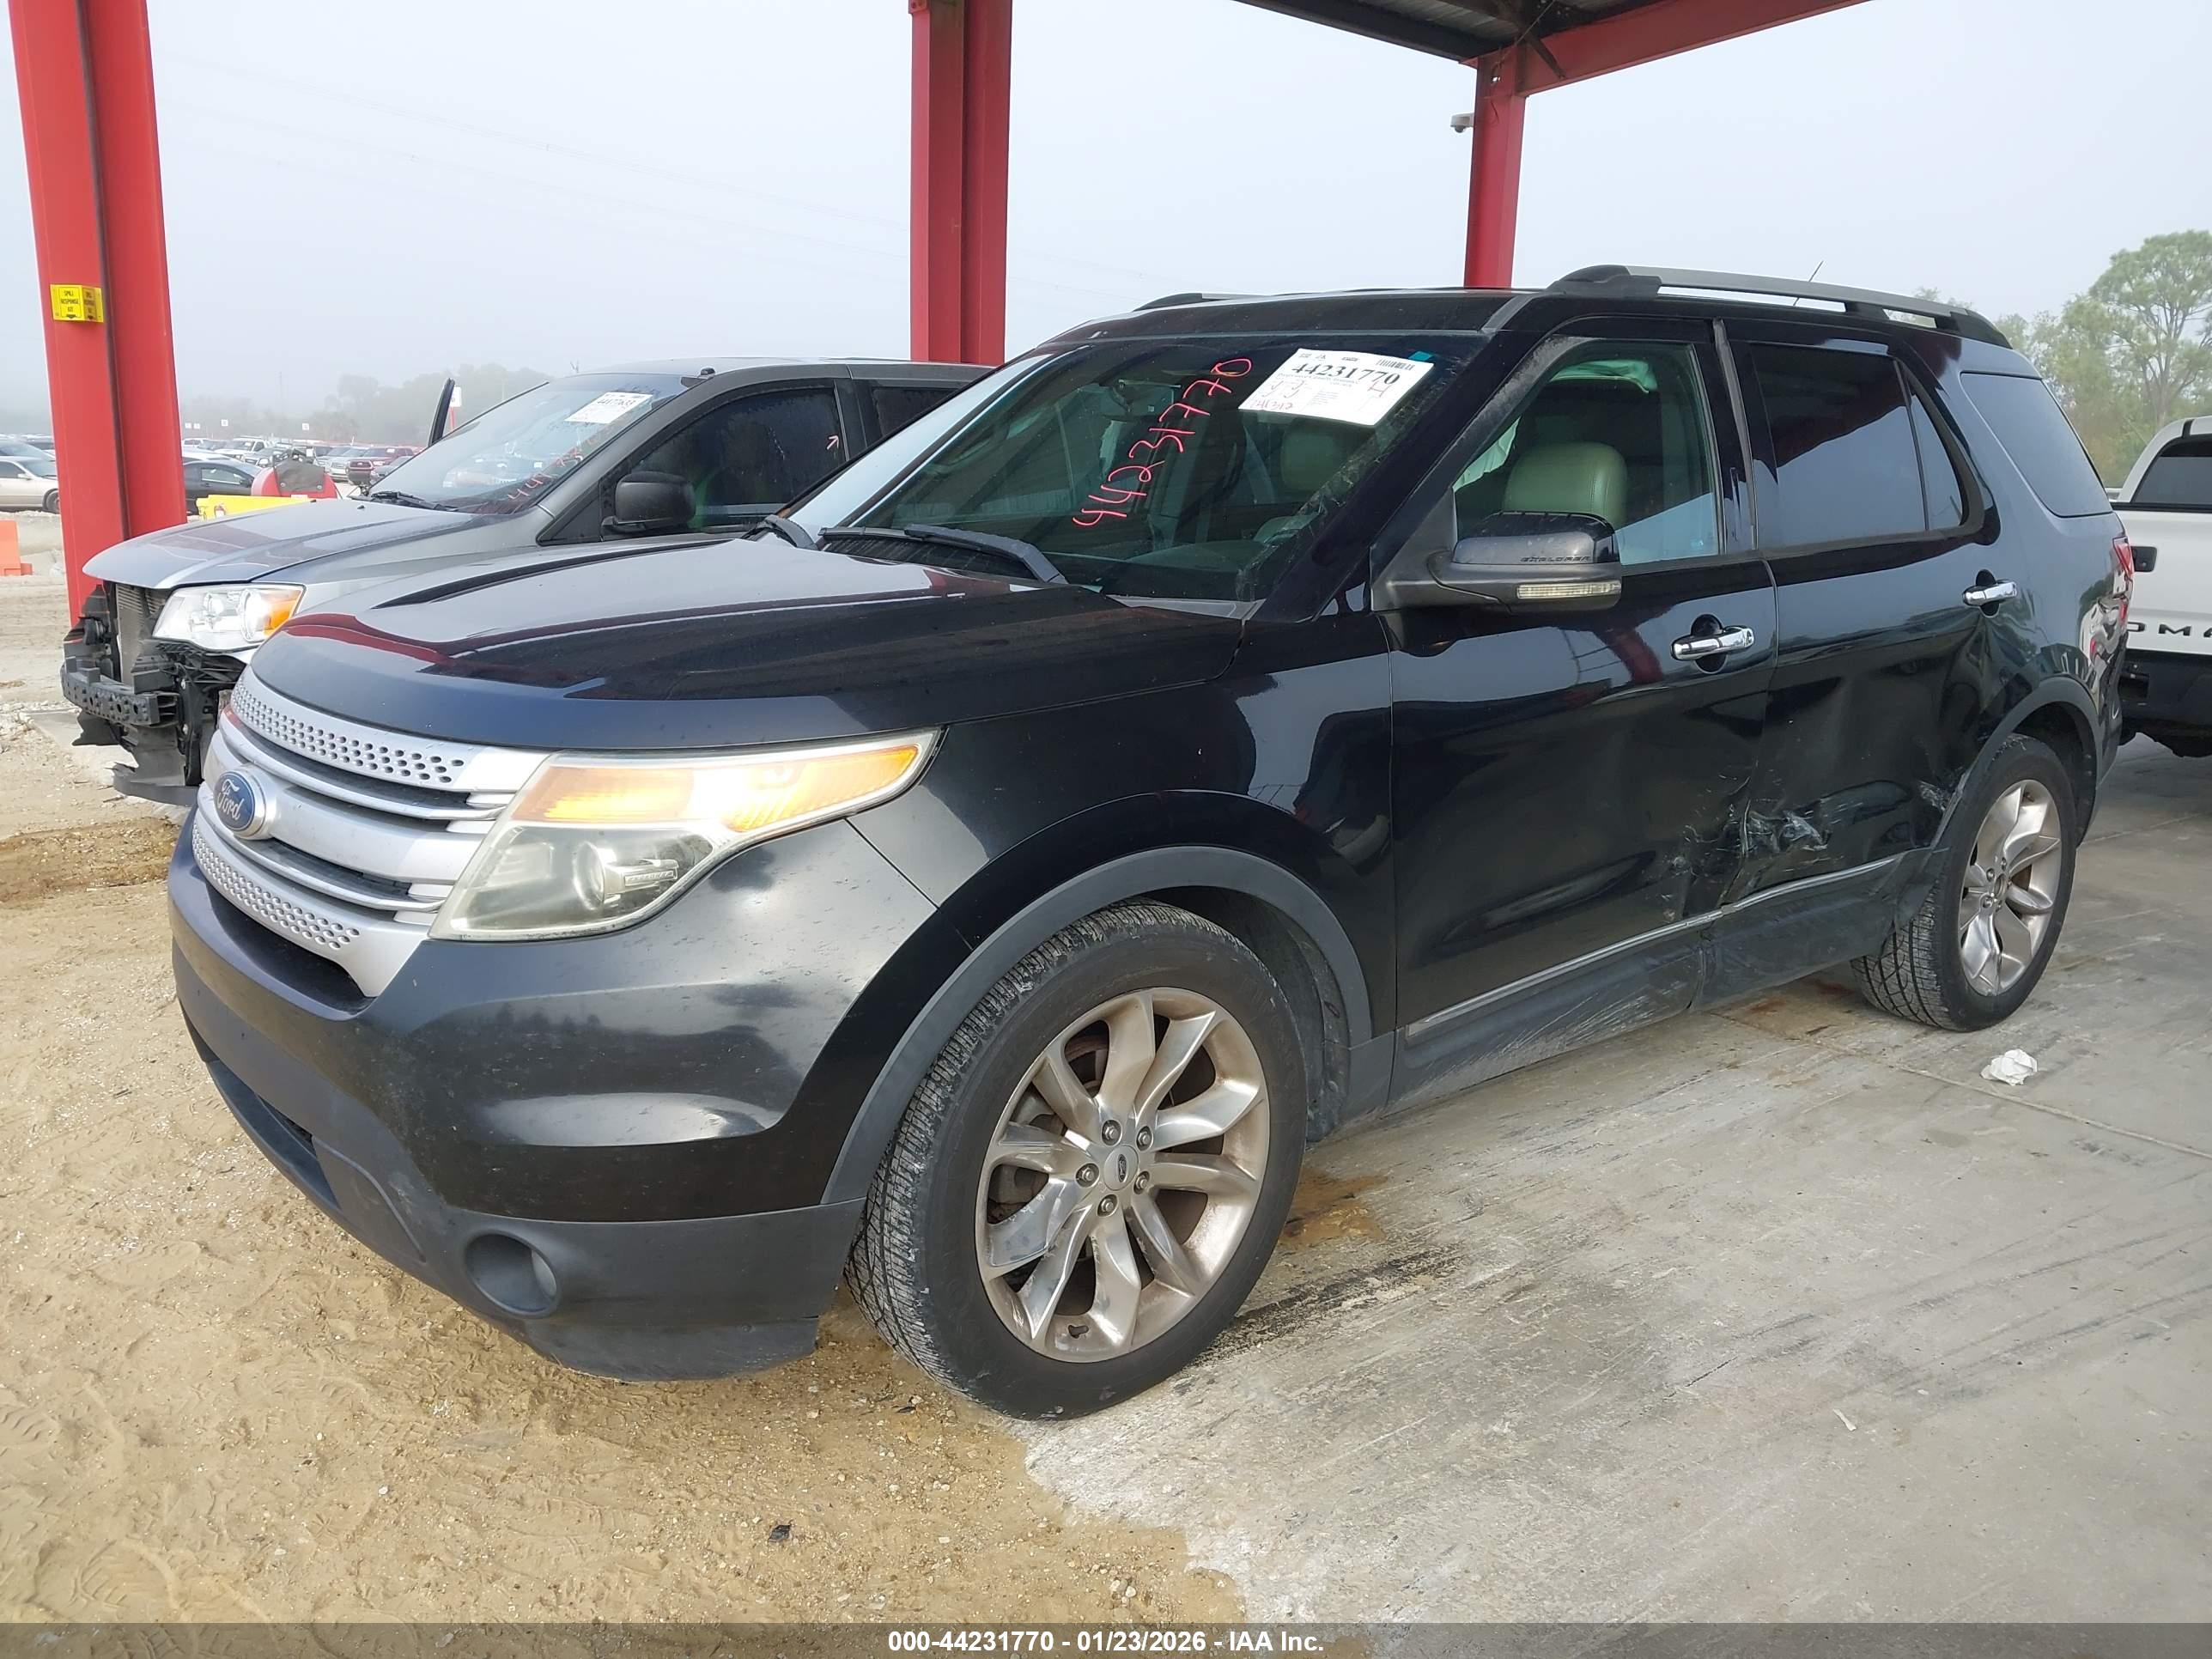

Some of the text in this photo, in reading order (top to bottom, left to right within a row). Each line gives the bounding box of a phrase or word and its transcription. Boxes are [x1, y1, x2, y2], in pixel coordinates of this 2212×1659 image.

[1292, 363, 1401, 386] 44231770
[1073, 359, 1251, 526] 44231770
[217, 779, 245, 821] Ford
